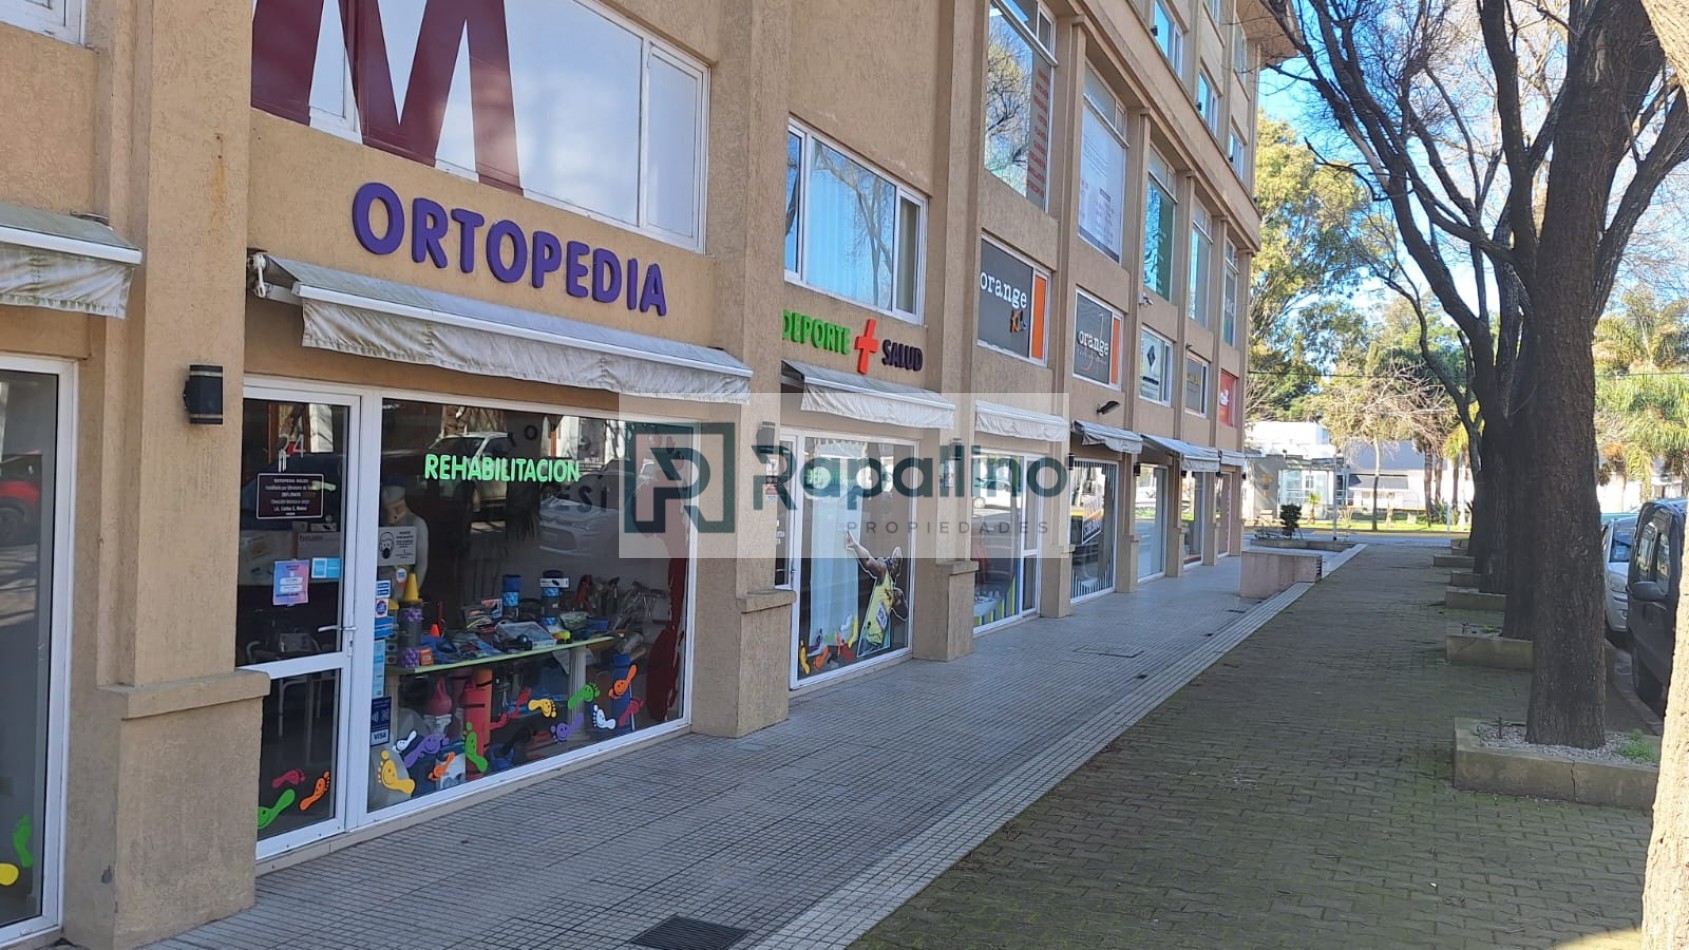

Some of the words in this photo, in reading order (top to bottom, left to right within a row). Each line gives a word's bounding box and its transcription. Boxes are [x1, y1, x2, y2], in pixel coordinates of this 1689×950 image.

[351, 181, 668, 317] ORTOPEDIA
[979, 272, 1028, 309] orange
[782, 309, 852, 355] DEPORTE
[881, 338, 924, 372] SALUD
[1078, 330, 1109, 357] orange
[424, 453, 581, 482] REHABILITACION
[373, 732, 388, 741] VISA
